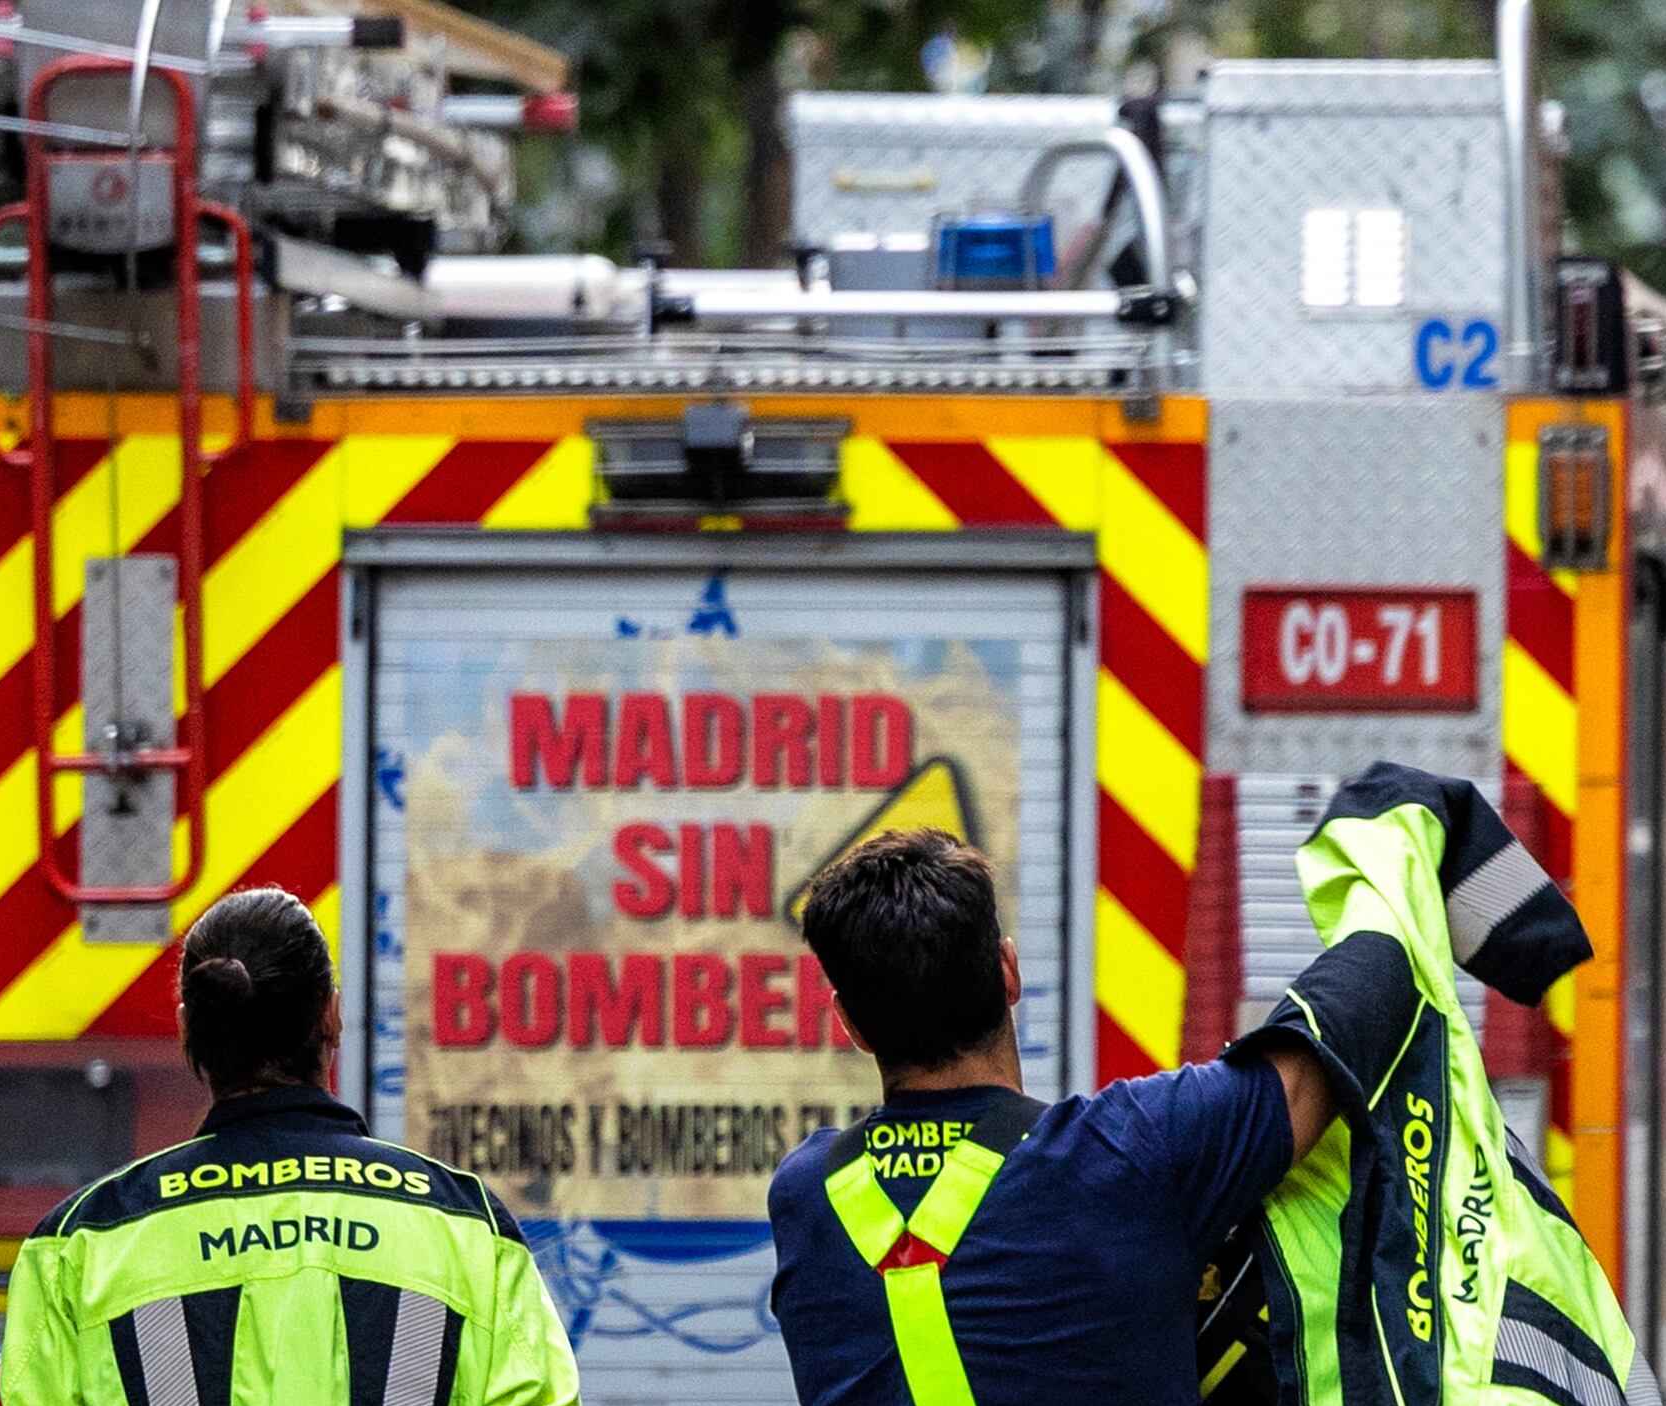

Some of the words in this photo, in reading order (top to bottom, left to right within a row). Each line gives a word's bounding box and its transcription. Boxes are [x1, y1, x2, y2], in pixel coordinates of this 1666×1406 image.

[1415, 319, 1499, 389] C2
[510, 693, 914, 789] MADRID
[613, 824, 772, 919] SIN
[618, 1104, 786, 1177] BOMBEROS
[866, 1121, 974, 1149] OMBE
[872, 1151, 949, 1179] MAD
[159, 1156, 432, 1198] BOMBEROS
[199, 1215, 379, 1261] MADRID
[1451, 1143, 1494, 1304] MADRID
